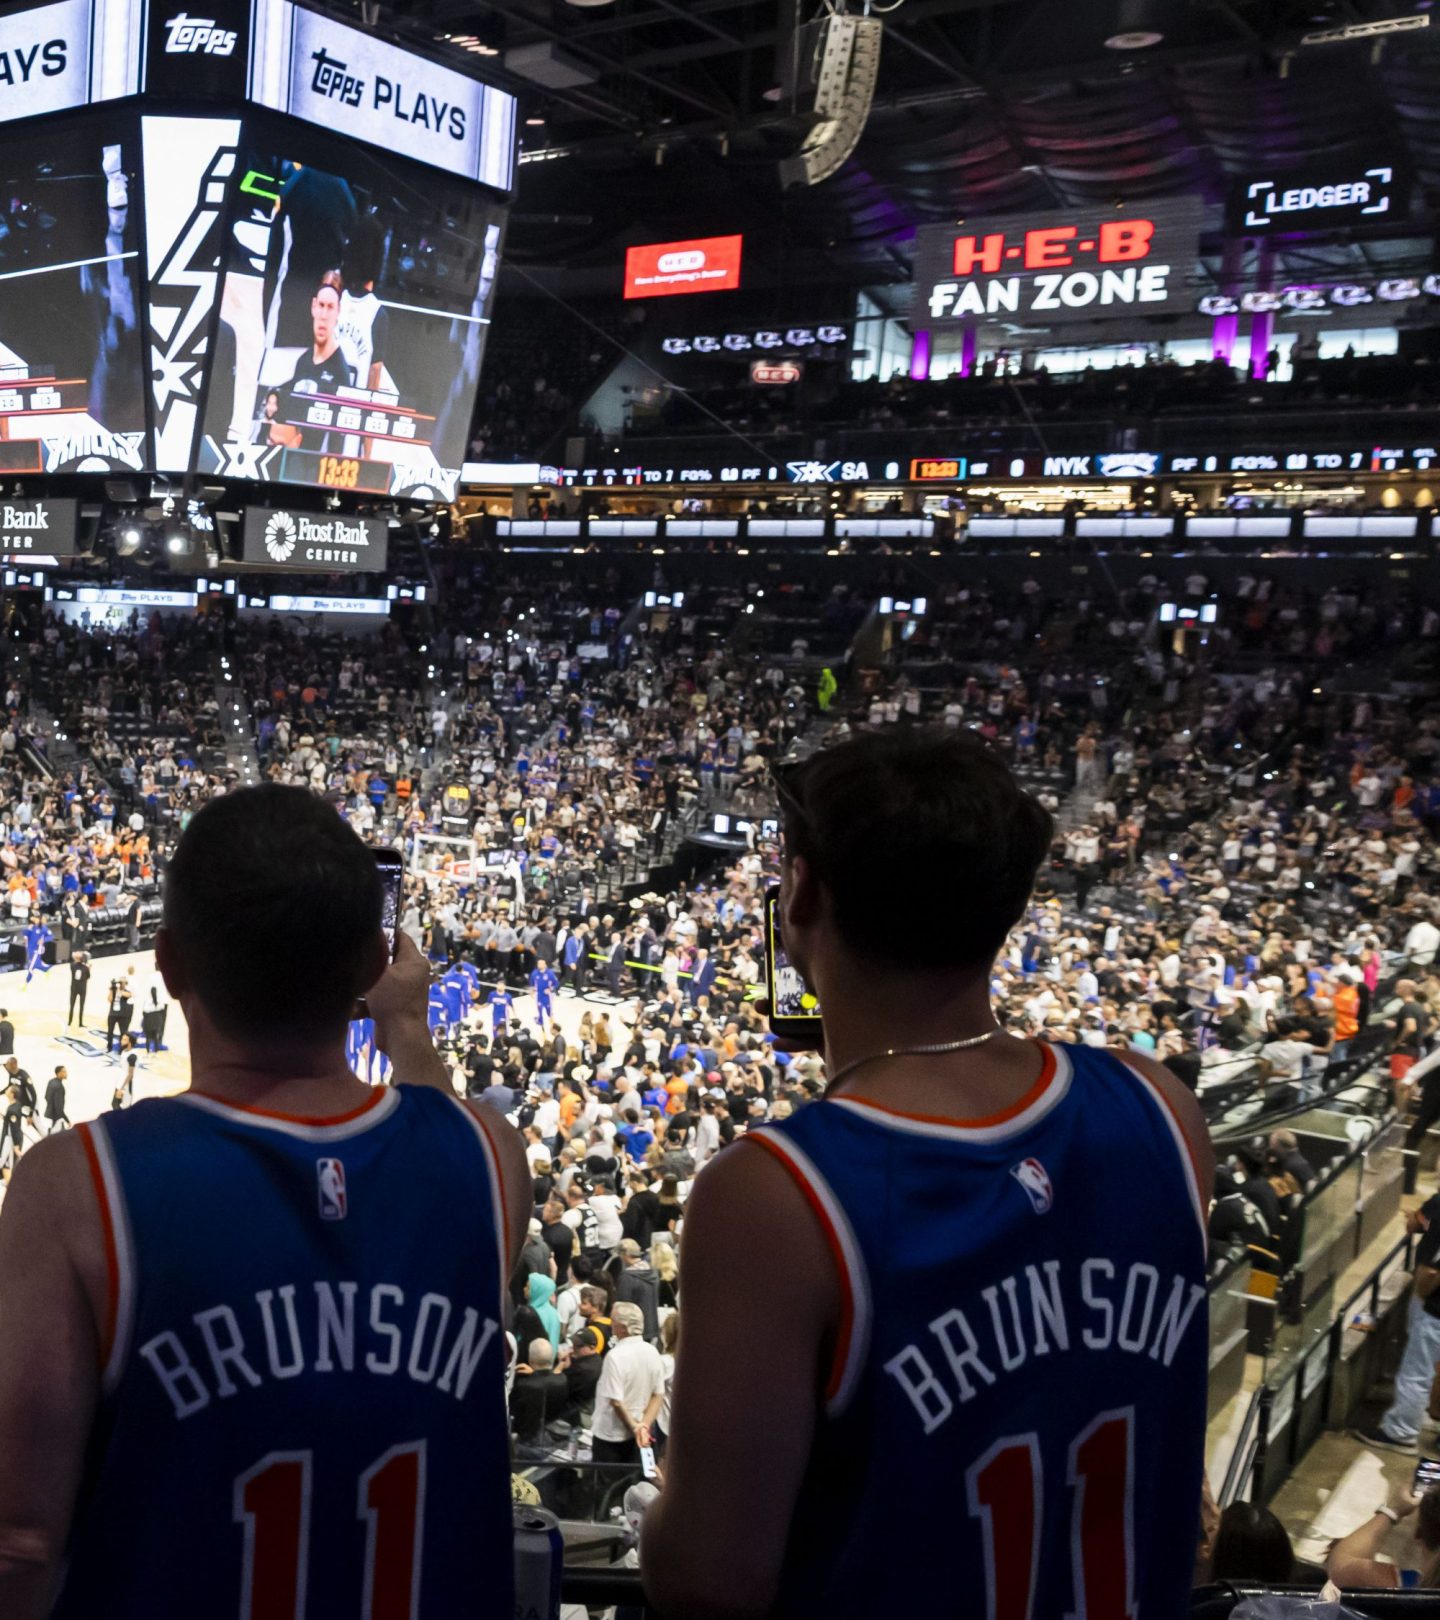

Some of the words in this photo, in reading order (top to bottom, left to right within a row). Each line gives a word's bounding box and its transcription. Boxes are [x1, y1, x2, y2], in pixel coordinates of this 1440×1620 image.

[373, 75, 467, 141] PLAYS
[1264, 181, 1371, 214] LEDGER
[927, 277, 1021, 318] FAN
[1031, 264, 1171, 311] ZONE
[318, 456, 360, 488] 13:33
[741, 467, 762, 481] PF
[840, 461, 868, 481] SA
[1044, 456, 1091, 477] NYK
[1171, 457, 1198, 471] PF
[1230, 456, 1278, 471] FG%
[1313, 454, 1343, 469] TO
[2, 502, 49, 530] Bank
[298, 517, 334, 543] Frost
[333, 519, 370, 546] Bank
[305, 548, 358, 564] CENTER
[138, 1280, 500, 1421] BRUNSON
[883, 1257, 1207, 1436] BRUNSON
[232, 1437, 428, 1620] 11
[964, 1403, 1140, 1620] 11
